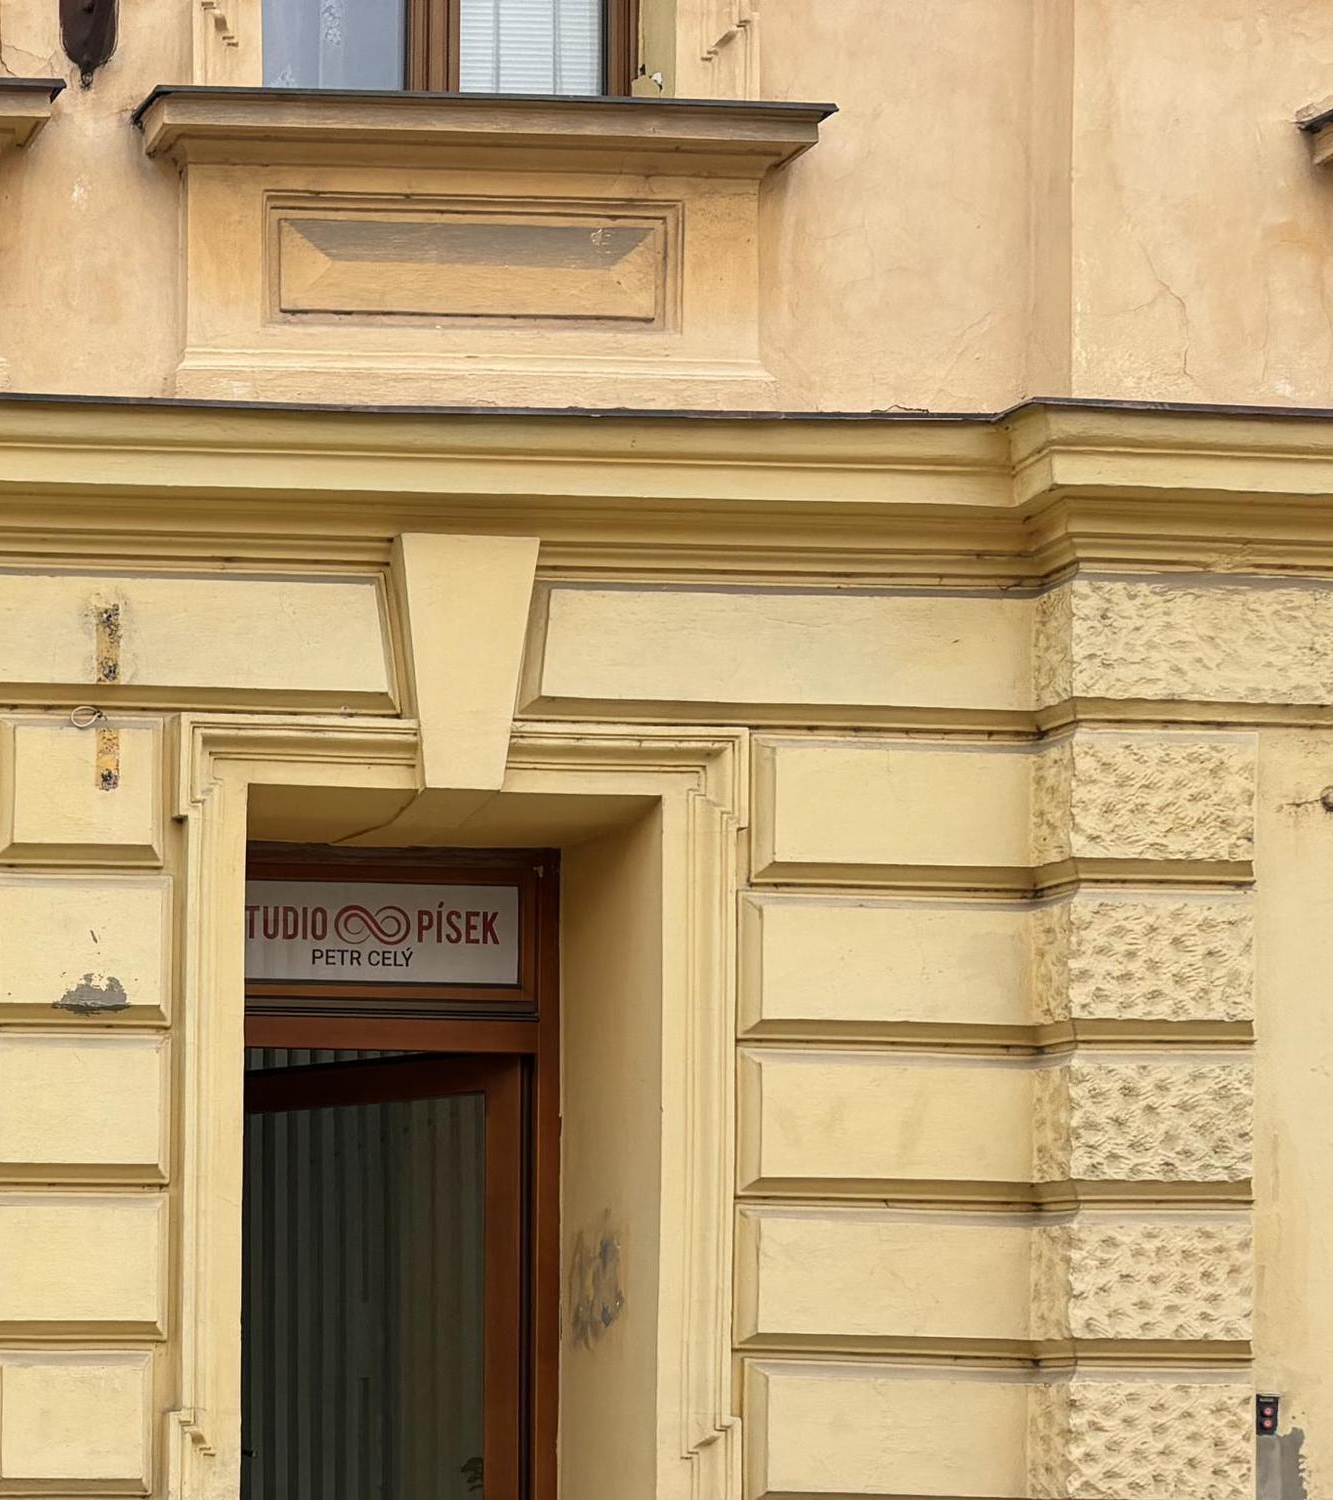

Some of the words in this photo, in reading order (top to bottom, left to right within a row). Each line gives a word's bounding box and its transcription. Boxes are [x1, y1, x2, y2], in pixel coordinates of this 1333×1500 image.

[244, 904, 328, 941] TUDIO
[417, 901, 501, 945] PÍSEK
[311, 948, 362, 967] PETR
[367, 946, 414, 968] CELÝ
